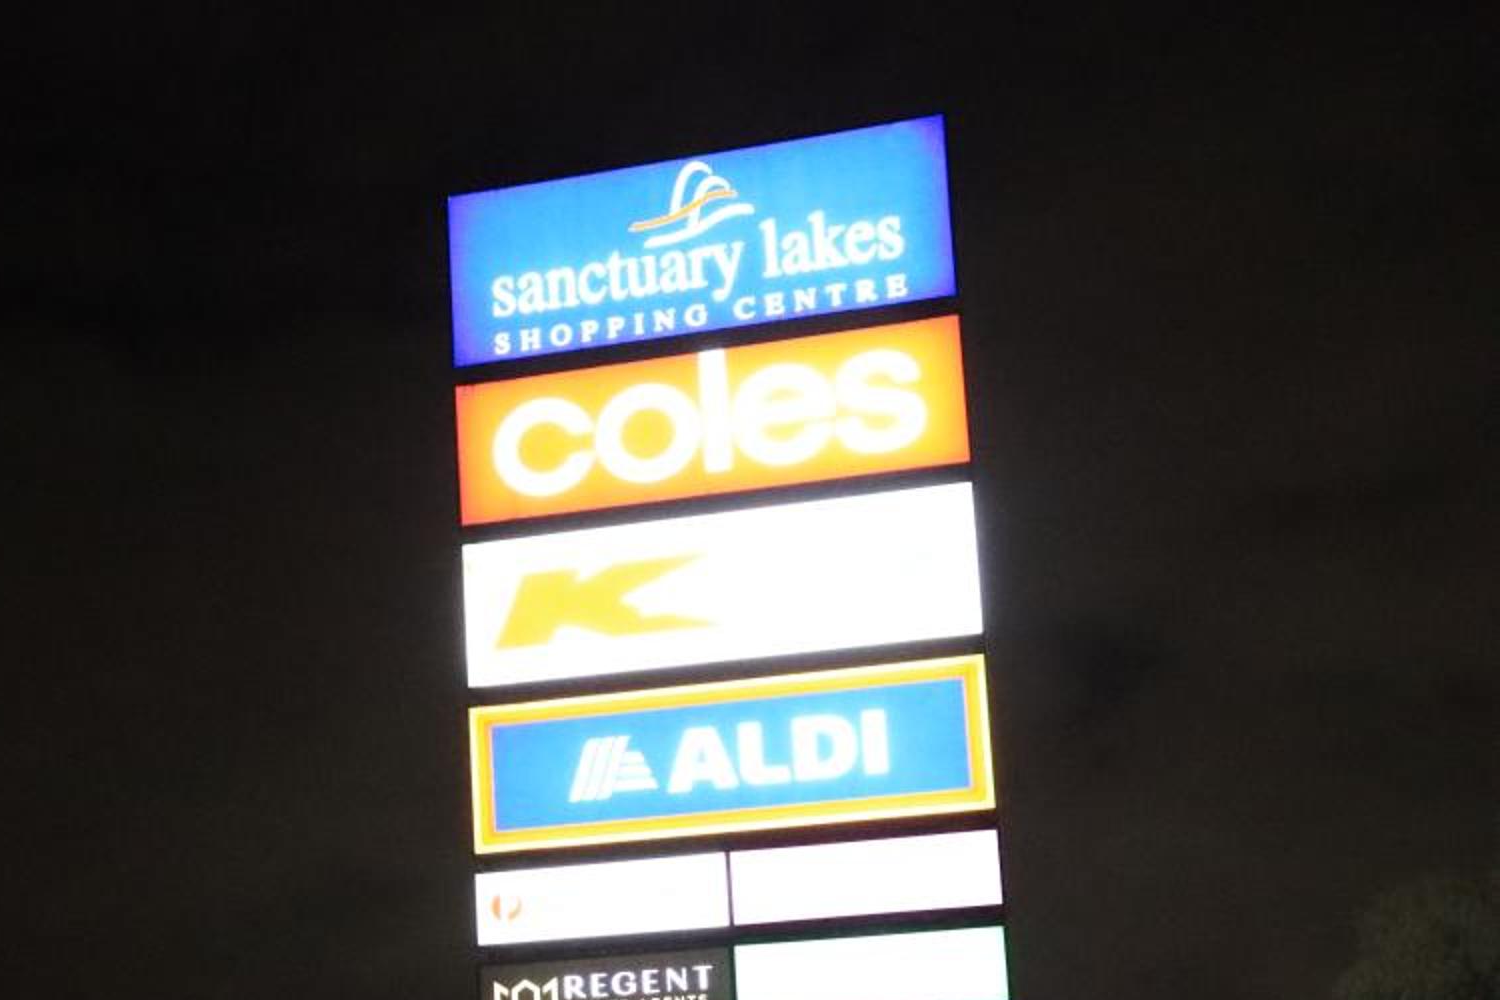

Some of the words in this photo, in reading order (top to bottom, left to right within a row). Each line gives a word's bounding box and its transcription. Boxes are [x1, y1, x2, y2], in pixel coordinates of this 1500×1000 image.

[490, 241, 744, 319] sanctuary
[759, 210, 904, 279] lakes
[494, 304, 708, 356] SHOPPING
[733, 273, 910, 321] CENTRE
[491, 348, 929, 498] coles
[666, 708, 891, 794] ALDI
[563, 965, 713, 1000] REGENT
